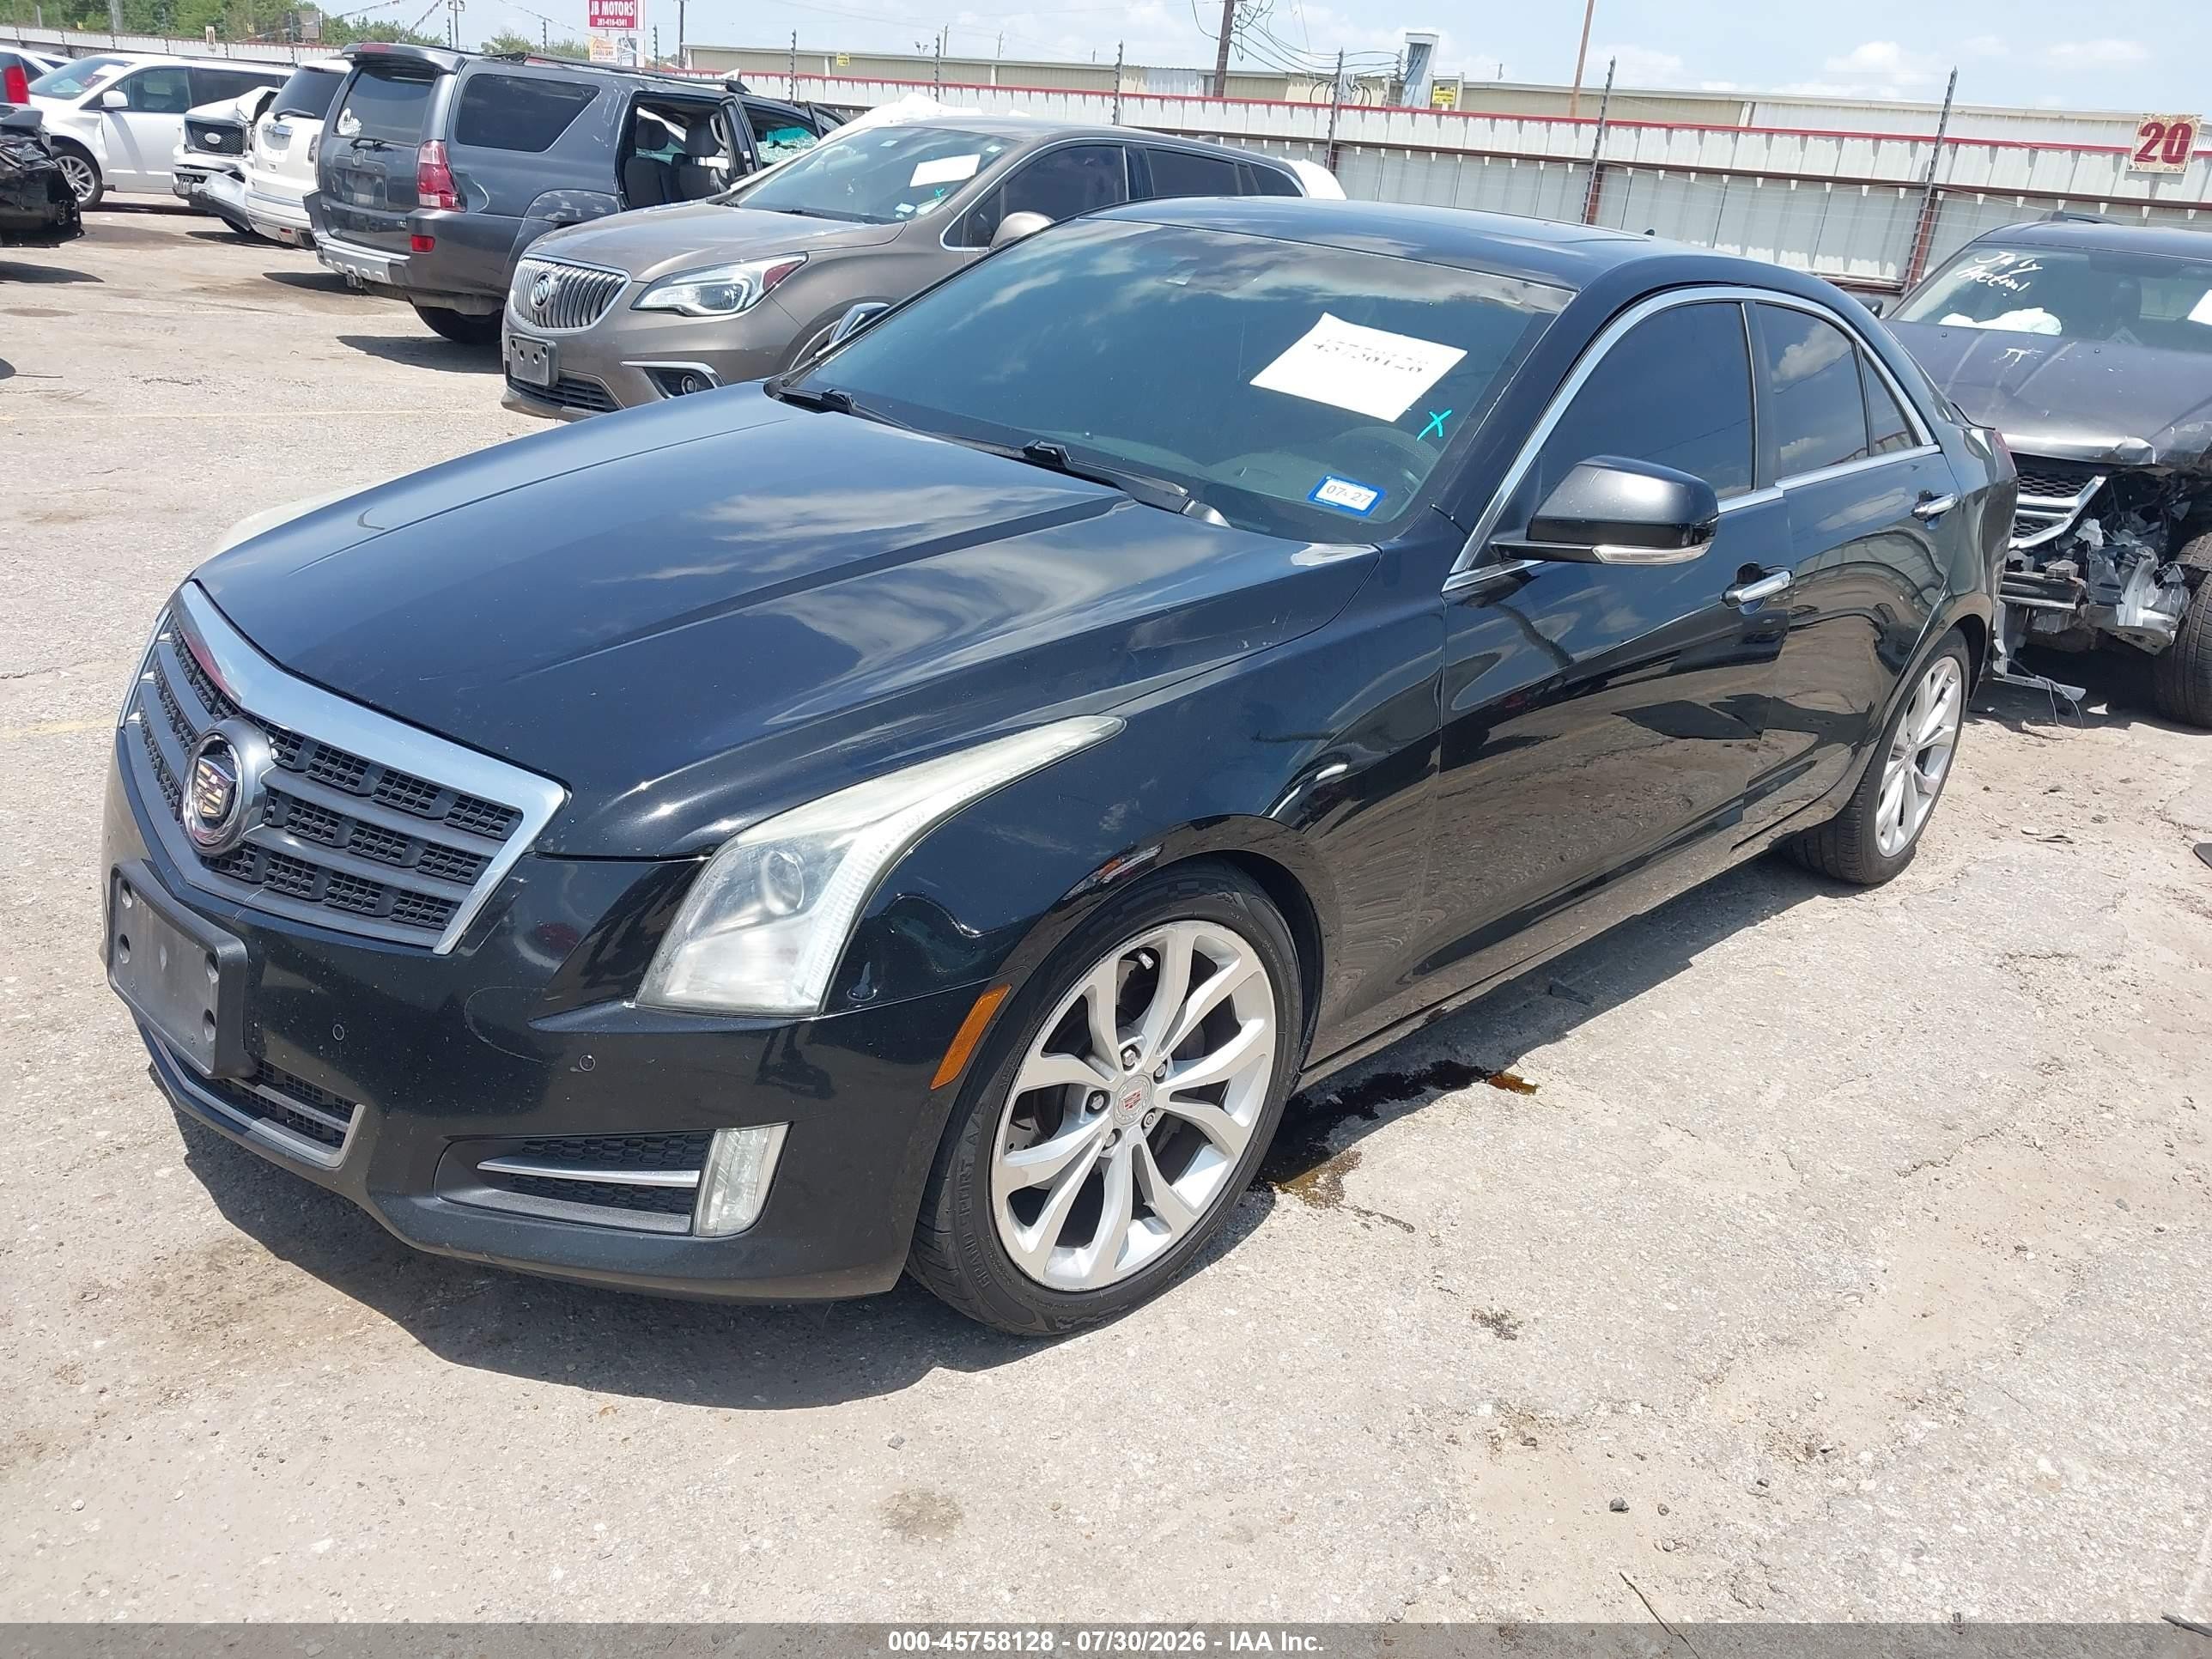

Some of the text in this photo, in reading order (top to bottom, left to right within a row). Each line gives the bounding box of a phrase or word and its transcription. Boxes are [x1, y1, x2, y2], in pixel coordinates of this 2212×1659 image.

[590, 1, 635, 16] JB MOTORS
[2134, 122, 2192, 164] 20
